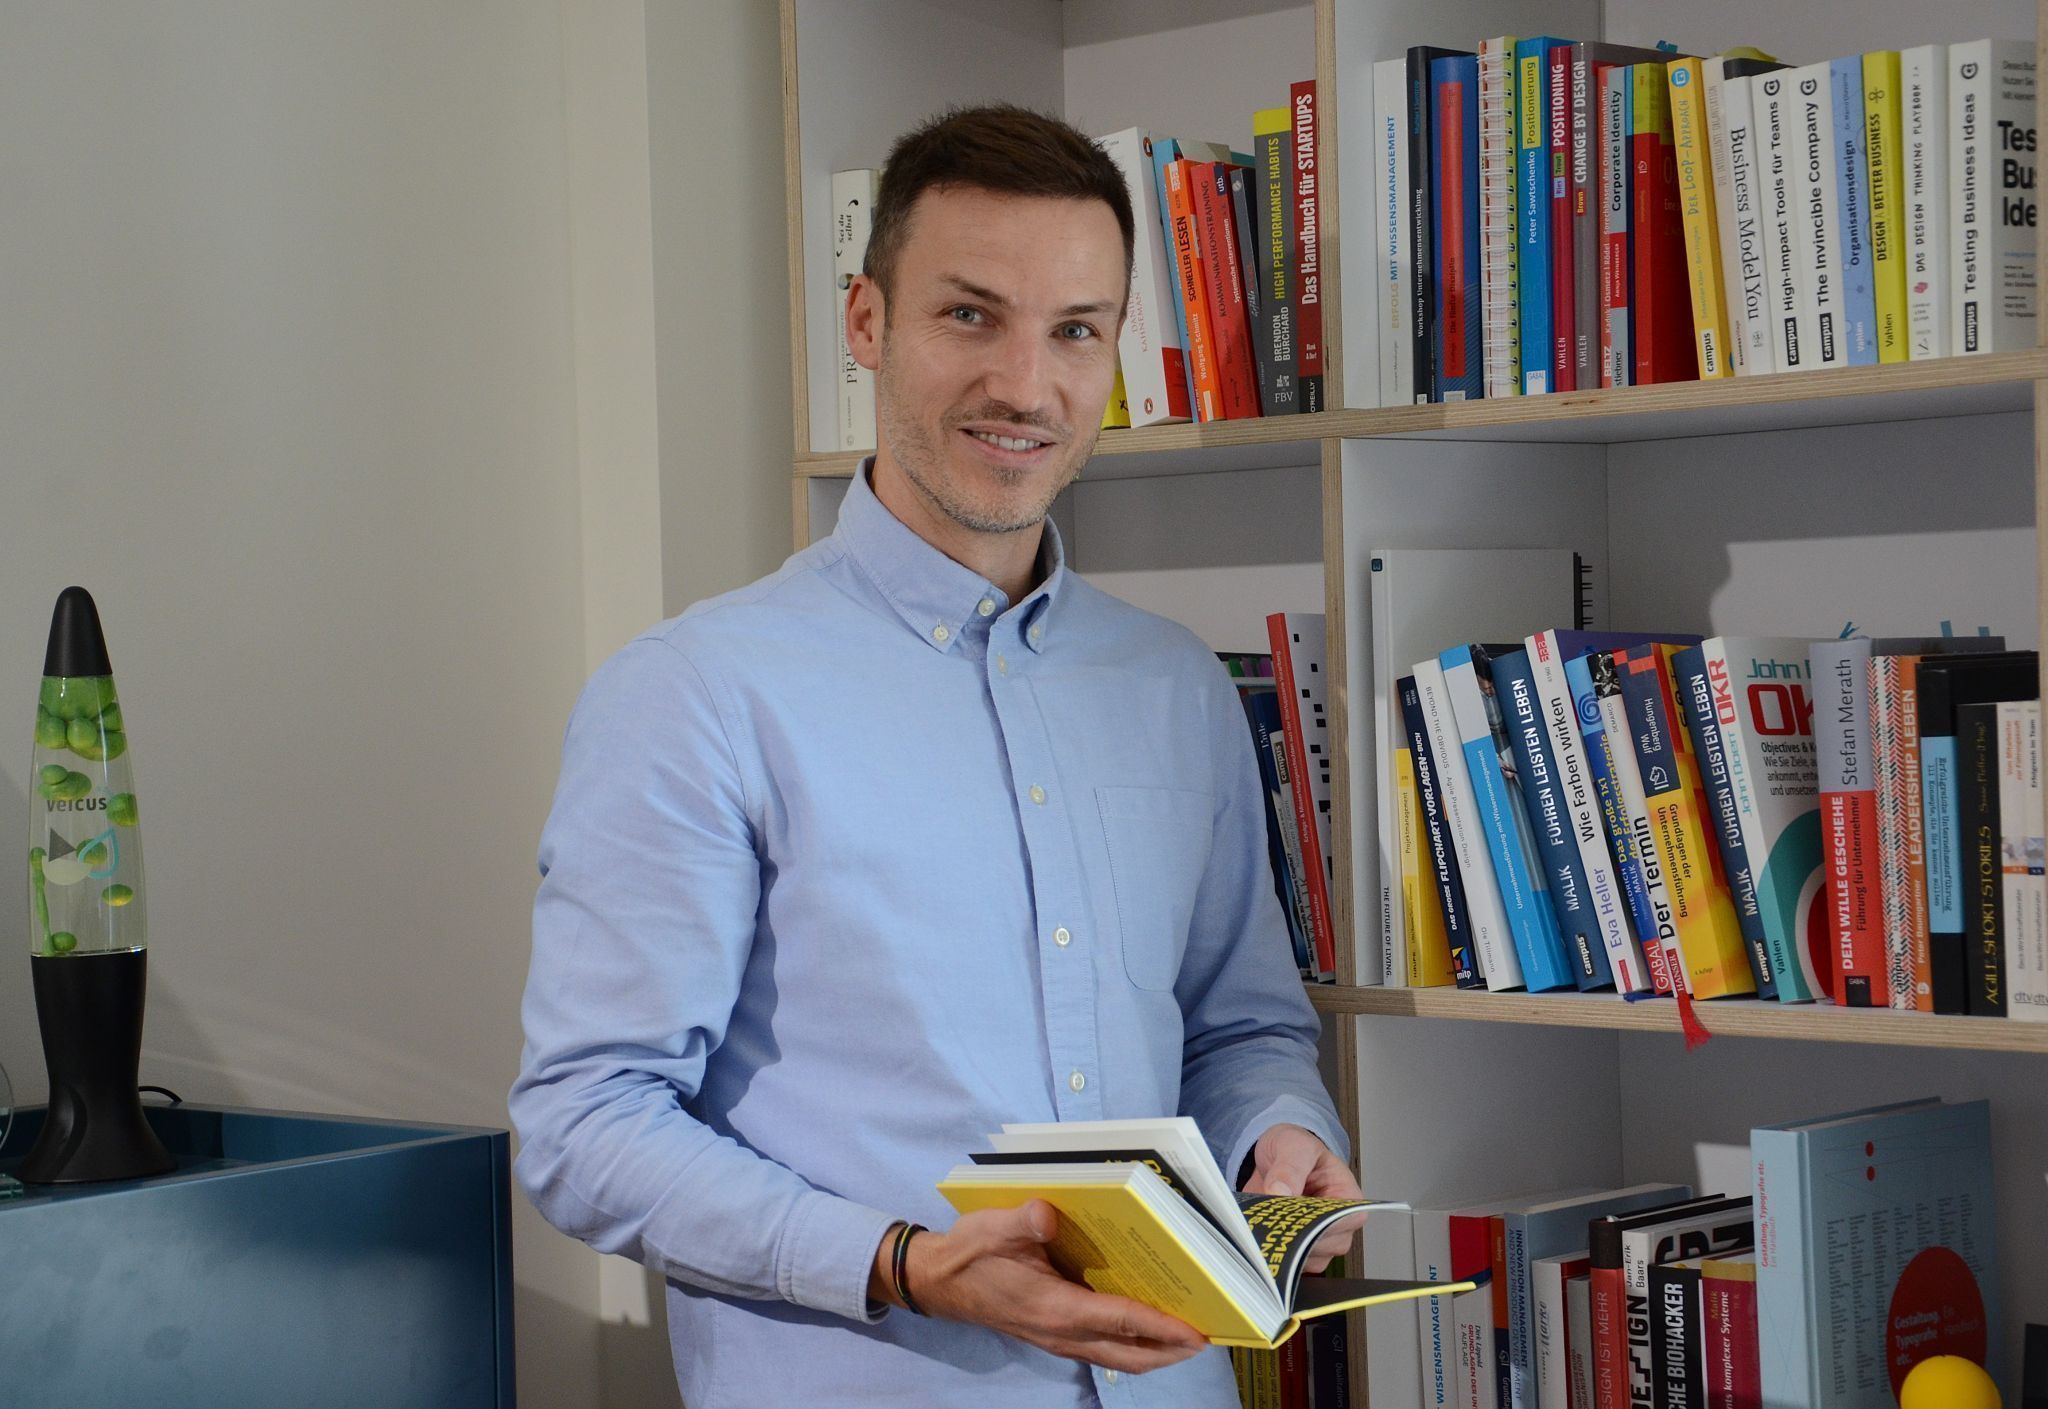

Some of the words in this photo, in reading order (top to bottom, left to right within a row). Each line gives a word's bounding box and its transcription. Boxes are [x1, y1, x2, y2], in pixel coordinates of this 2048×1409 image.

[1526, 62, 1536, 144] Positionierung
[1551, 64, 1565, 147] POSITIONING
[1573, 61, 1586, 108] DESIGN
[1296, 93, 1314, 170] STARTUPS
[1574, 112, 1586, 129] BY
[1610, 90, 1621, 143] Identity
[1769, 101, 1780, 150] Teams
[1912, 84, 1922, 135] PLAYBOOK
[1962, 93, 1975, 141] Ideas
[1268, 137, 1280, 179] HABITS
[1574, 131, 1587, 183] CHANGE
[1805, 102, 1821, 183] Company
[1870, 113, 1882, 167] BUSINESS
[1217, 175, 1225, 192] utb.
[1298, 172, 1315, 196] für
[1387, 116, 1398, 257] WISSENSMANAGEMENT
[1527, 151, 1536, 215] Sawtschenko
[1611, 145, 1623, 212] Corporate
[1730, 126, 1750, 213] Business
[1772, 154, 1783, 175] für
[1914, 142, 1923, 196] THINKING
[1962, 145, 1976, 224] Business
[1577, 191, 1585, 214] Brown
[1774, 178, 1786, 218] Tools
[1844, 139, 1860, 266] Organisationsdesign
[1872, 169, 1885, 210] BETTER
[1176, 215, 1190, 252] LESEN
[1270, 182, 1283, 267] PERFORMANCE
[1299, 197, 1317, 274] Handbuch
[1414, 188, 1423, 296] Unternehmensentwicklung
[1528, 217, 1536, 244] Peter
[1810, 187, 1826, 270] Invincible
[1874, 221, 1887, 262] DESIGN
[1914, 203, 1925, 246] DESIGN
[1183, 253, 1196, 302] SCHNELLER
[1390, 259, 1398, 281] MIT
[1777, 221, 1794, 311] High-Impact
[1915, 252, 1926, 273] DAS
[1964, 229, 1978, 294] Testing
[1273, 271, 1285, 299] HIGH
[1301, 275, 1318, 305] Das
[1817, 273, 1829, 307] The
[1191, 312, 1202, 343] Schmitz
[1273, 315, 1282, 362] BRENDON
[1281, 306, 1290, 361] BURCHARD
[1786, 320, 1797, 362] campus
[1821, 316, 1832, 358] campus
[1855, 321, 1865, 352] Vahlen
[1884, 313, 1894, 348] Vahlen
[1967, 305, 1977, 349] campus
[1196, 344, 1207, 380] Wolfgang
[1558, 337, 1566, 370] VAHLEN
[1579, 334, 1587, 368] VAHLEN
[1604, 345, 1612, 377] BELTZ
[1613, 350, 1622, 386] stiebner
[1702, 332, 1714, 373] campus
[1275, 391, 1293, 404] FBV
[1747, 658, 1801, 679] John
[1426, 685, 1438, 716] BEYOND
[1511, 677, 1534, 724] LEBEN
[1690, 673, 1713, 722] LEBEN
[1704, 657, 1736, 726] OKR
[1835, 659, 1854, 723] Merath
[1434, 719, 1442, 734] THE
[1549, 696, 1573, 752] wirken
[1643, 697, 1662, 752] Hungenberg
[1902, 689, 1917, 748] LEBEN
[1275, 744, 1287, 782] campus
[1437, 735, 1449, 769] OBVIOUS
[1523, 727, 1548, 786] LEISTEN
[1639, 733, 1653, 754] Wulf
[1702, 724, 1728, 785] LEISTEN
[1761, 741, 1801, 756] Objectives
[1763, 756, 1778, 768] Wie
[1779, 756, 1790, 768] Sie
[1840, 728, 1858, 785] Stefan
[2030, 739, 2036, 748] im
[1477, 749, 1501, 821] Wissensmanagement
[1565, 753, 1586, 808] Farben
[1597, 776, 1609, 798] 1x1
[1599, 733, 1632, 835] Erfolgsstrategie
[1770, 785, 1786, 796] und
[2029, 750, 2038, 788] Erfolgreich
[1402, 791, 1411, 855] Projektmanagement
[1414, 731, 1449, 882] FLIPCHART-VORLAGEN-BUCH
[1495, 821, 1504, 833] mit
[1538, 787, 1564, 846] FÜHREN
[1578, 810, 1595, 843] Wie
[1602, 799, 1623, 837] große
[1717, 787, 1742, 848] FÜHREN
[1904, 752, 1922, 865] LEADERSHIP
[1614, 838, 1628, 864] Das
[1625, 838, 1639, 860] der
[1669, 803, 1687, 861] Grundlagen
[1681, 862, 1692, 879] der
[1832, 796, 1848, 877] GESCHEHE
[1850, 795, 1863, 867] Unternehmer
[1499, 833, 1524, 910] Unternehmensführung
[1632, 815, 1663, 895] Termin
[1657, 806, 1689, 918] Unternehmensführung
[1852, 869, 1864, 884] für
[1978, 825, 1994, 897] STORIES
[1443, 884, 1454, 913] GROSSE
[1558, 864, 1580, 912] MALIK
[1592, 867, 1614, 916] Heller
[1620, 867, 1638, 918] FRIEDRICH
[1628, 864, 1642, 894] MALIK
[1735, 867, 1758, 916] MALIK
[1449, 914, 1457, 930] DAS
[1653, 901, 1676, 941] Der
[1837, 879, 1851, 927] WILLE
[1854, 886, 1867, 932] Führung
[1914, 879, 1924, 938] Baumgartner
[1384, 935, 1391, 945] OF
[1607, 919, 1622, 949] Eva
[1840, 931, 1854, 969] DEIN
[1981, 902, 1997, 956] SHORT
[1577, 935, 1592, 975] campus
[1647, 942, 1669, 990] GABAL
[1668, 954, 1685, 992] HANSER
[1754, 941, 1771, 982] campus
[1772, 939, 1786, 975] Vahlen
[1917, 939, 1926, 964] Peter
[1456, 970, 1471, 980] mitp
[1758, 1177, 1768, 1220] Typografie
[1508, 1229, 1517, 1253] AND
[1515, 1229, 1525, 1294] INNOVATION
[1509, 1254, 1517, 1277] NEW
[1624, 1243, 1633, 1288] Jan-Erik
[1636, 1259, 1645, 1288] Baars
[1510, 1278, 1519, 1329] PRODUCT
[1597, 1291, 1609, 1335] MEHR
[1710, 1290, 1719, 1320] Malik
[1720, 1291, 1731, 1335] Systeme
[1428, 1264, 1445, 1405] WISSENSMANAGENT
[1461, 1331, 1469, 1367] AUFLAGE
[1467, 1324, 1477, 1377] GRUNDLAGEN
[1518, 1295, 1528, 1368] MANAGEMENT
[1600, 1341, 1610, 1363] IST
[1664, 1282, 1686, 1379] BIOHACKER
[1511, 1330, 1521, 1401] DEVELOPMENT
[1721, 1337, 1733, 1391] komplexer
